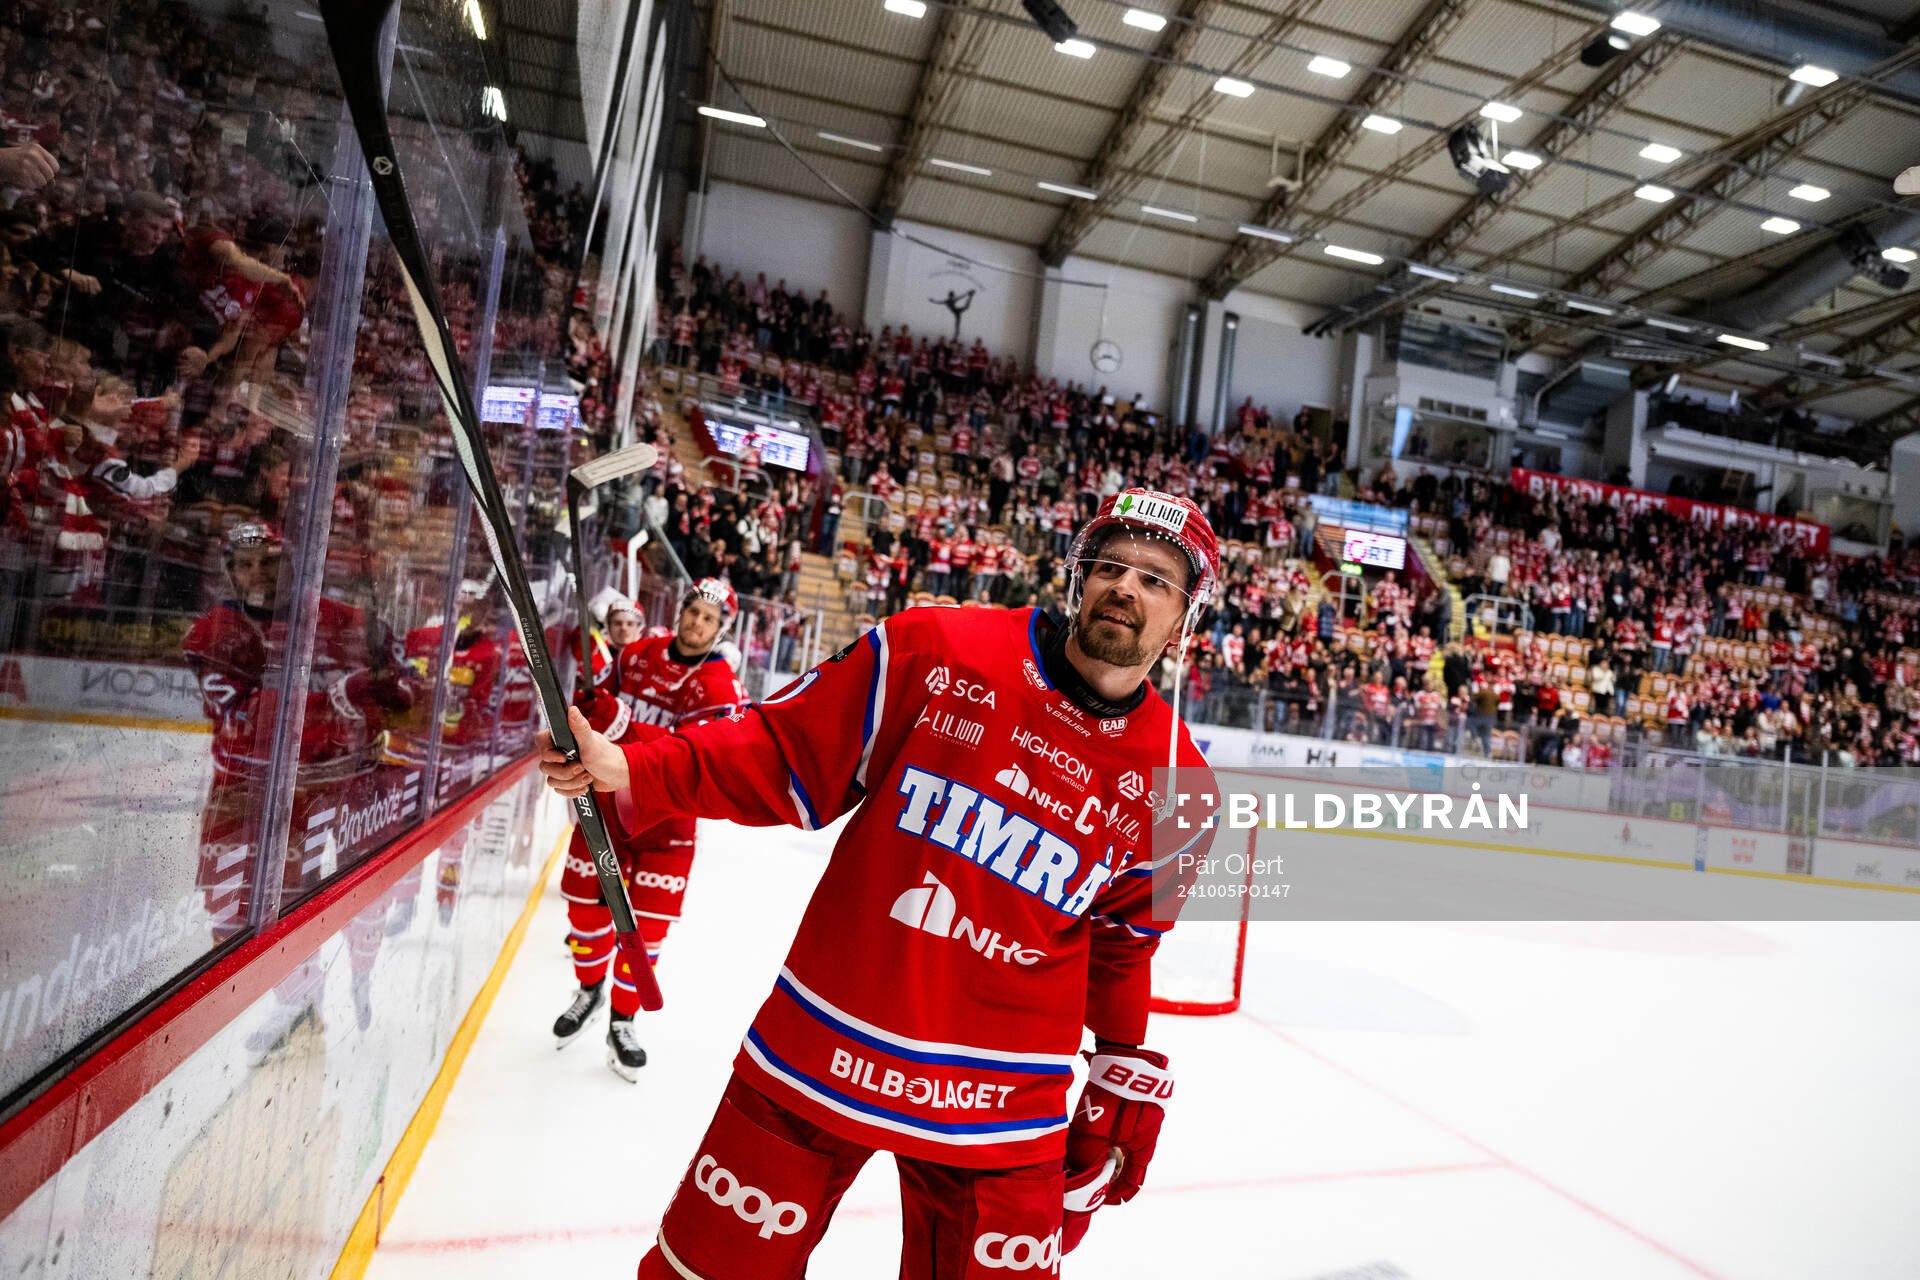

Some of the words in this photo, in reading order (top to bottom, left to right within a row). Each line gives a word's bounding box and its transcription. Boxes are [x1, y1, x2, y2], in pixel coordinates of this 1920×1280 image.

[1137, 499, 1185, 527] LILIUM
[952, 679, 996, 711] SCA
[1059, 700, 1085, 721] SHL
[932, 709, 985, 746] LILIUM
[1101, 719, 1126, 732] EAB
[1010, 726, 1093, 785] HIGHCON
[1028, 786, 1075, 822] NHC
[1074, 795, 1102, 836] C
[897, 764, 1114, 918] TIMRÅ
[635, 871, 686, 894] coop
[951, 915, 1048, 966] NHC
[829, 1047, 1017, 1110] BILBOLAGET
[1101, 1063, 1175, 1100] BAU
[694, 1153, 808, 1240] coop
